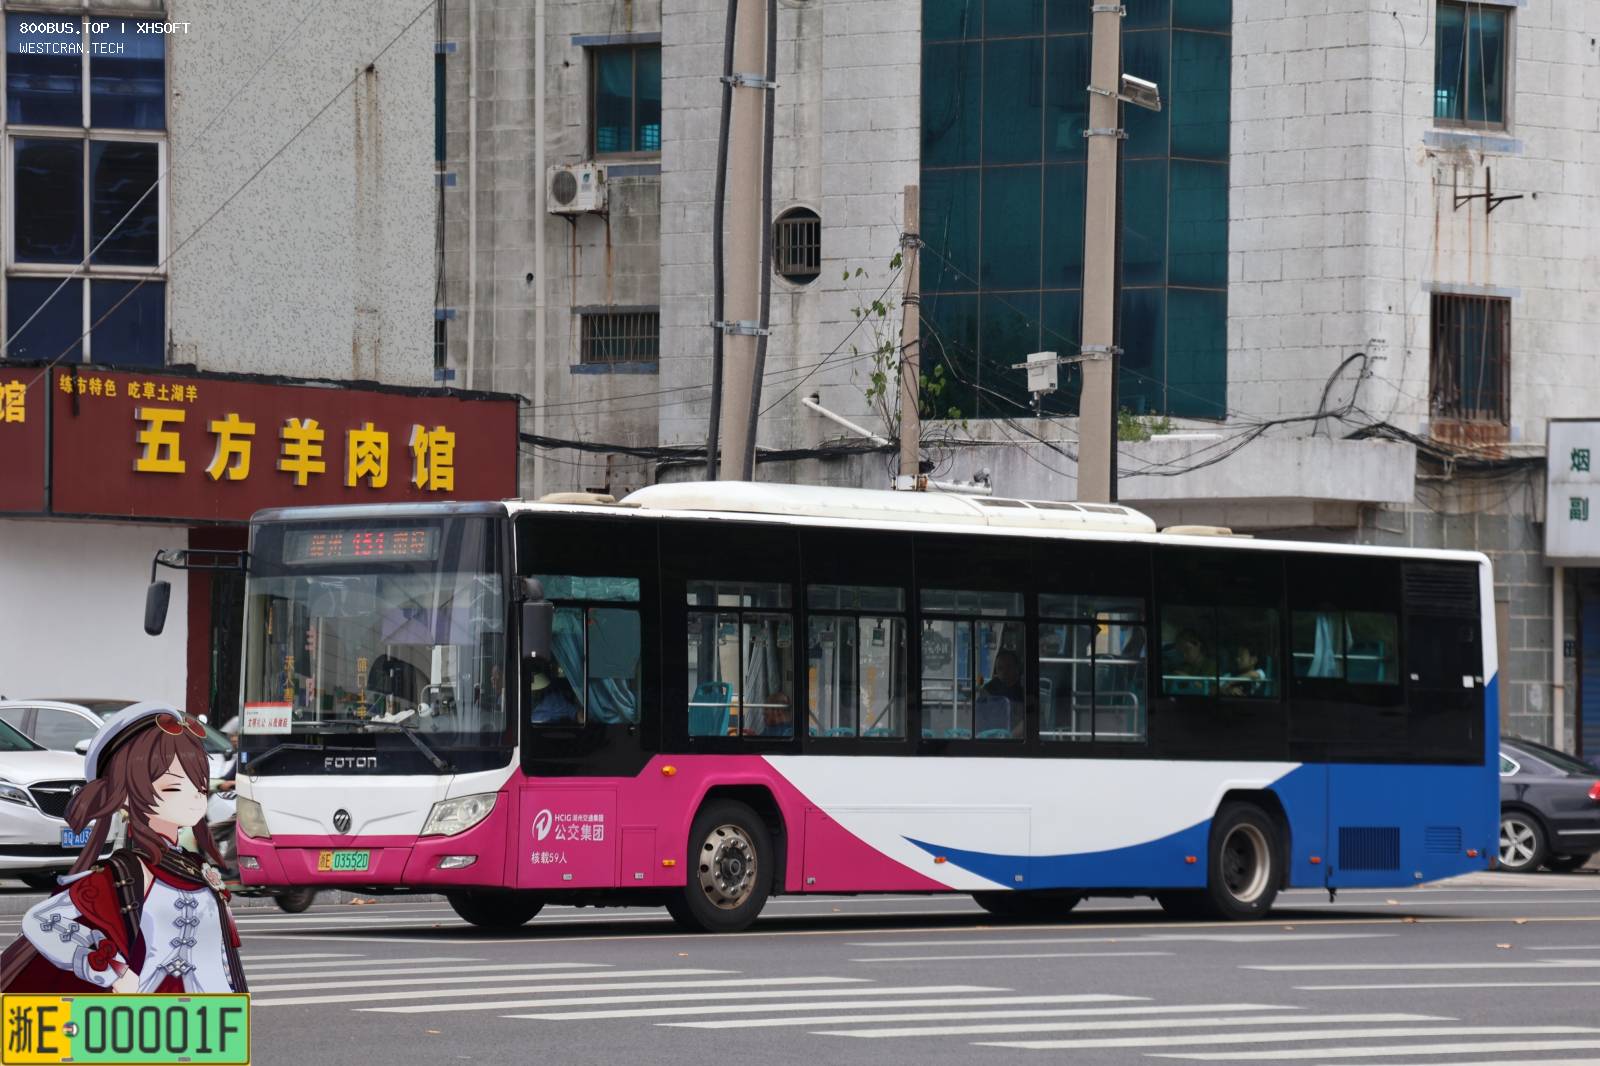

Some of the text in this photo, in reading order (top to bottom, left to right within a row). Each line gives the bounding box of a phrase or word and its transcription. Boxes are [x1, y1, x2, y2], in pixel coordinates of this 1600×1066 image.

[59, 374, 198, 403] 练市特色 吃草土湖羊
[133, 407, 456, 491] 五方羊肉馆
[352, 532, 385, 556] 151
[324, 756, 377, 769] FOTON
[554, 814, 572, 822] HCIG
[555, 824, 604, 841] 公交集团
[531, 851, 567, 865] 核载59人
